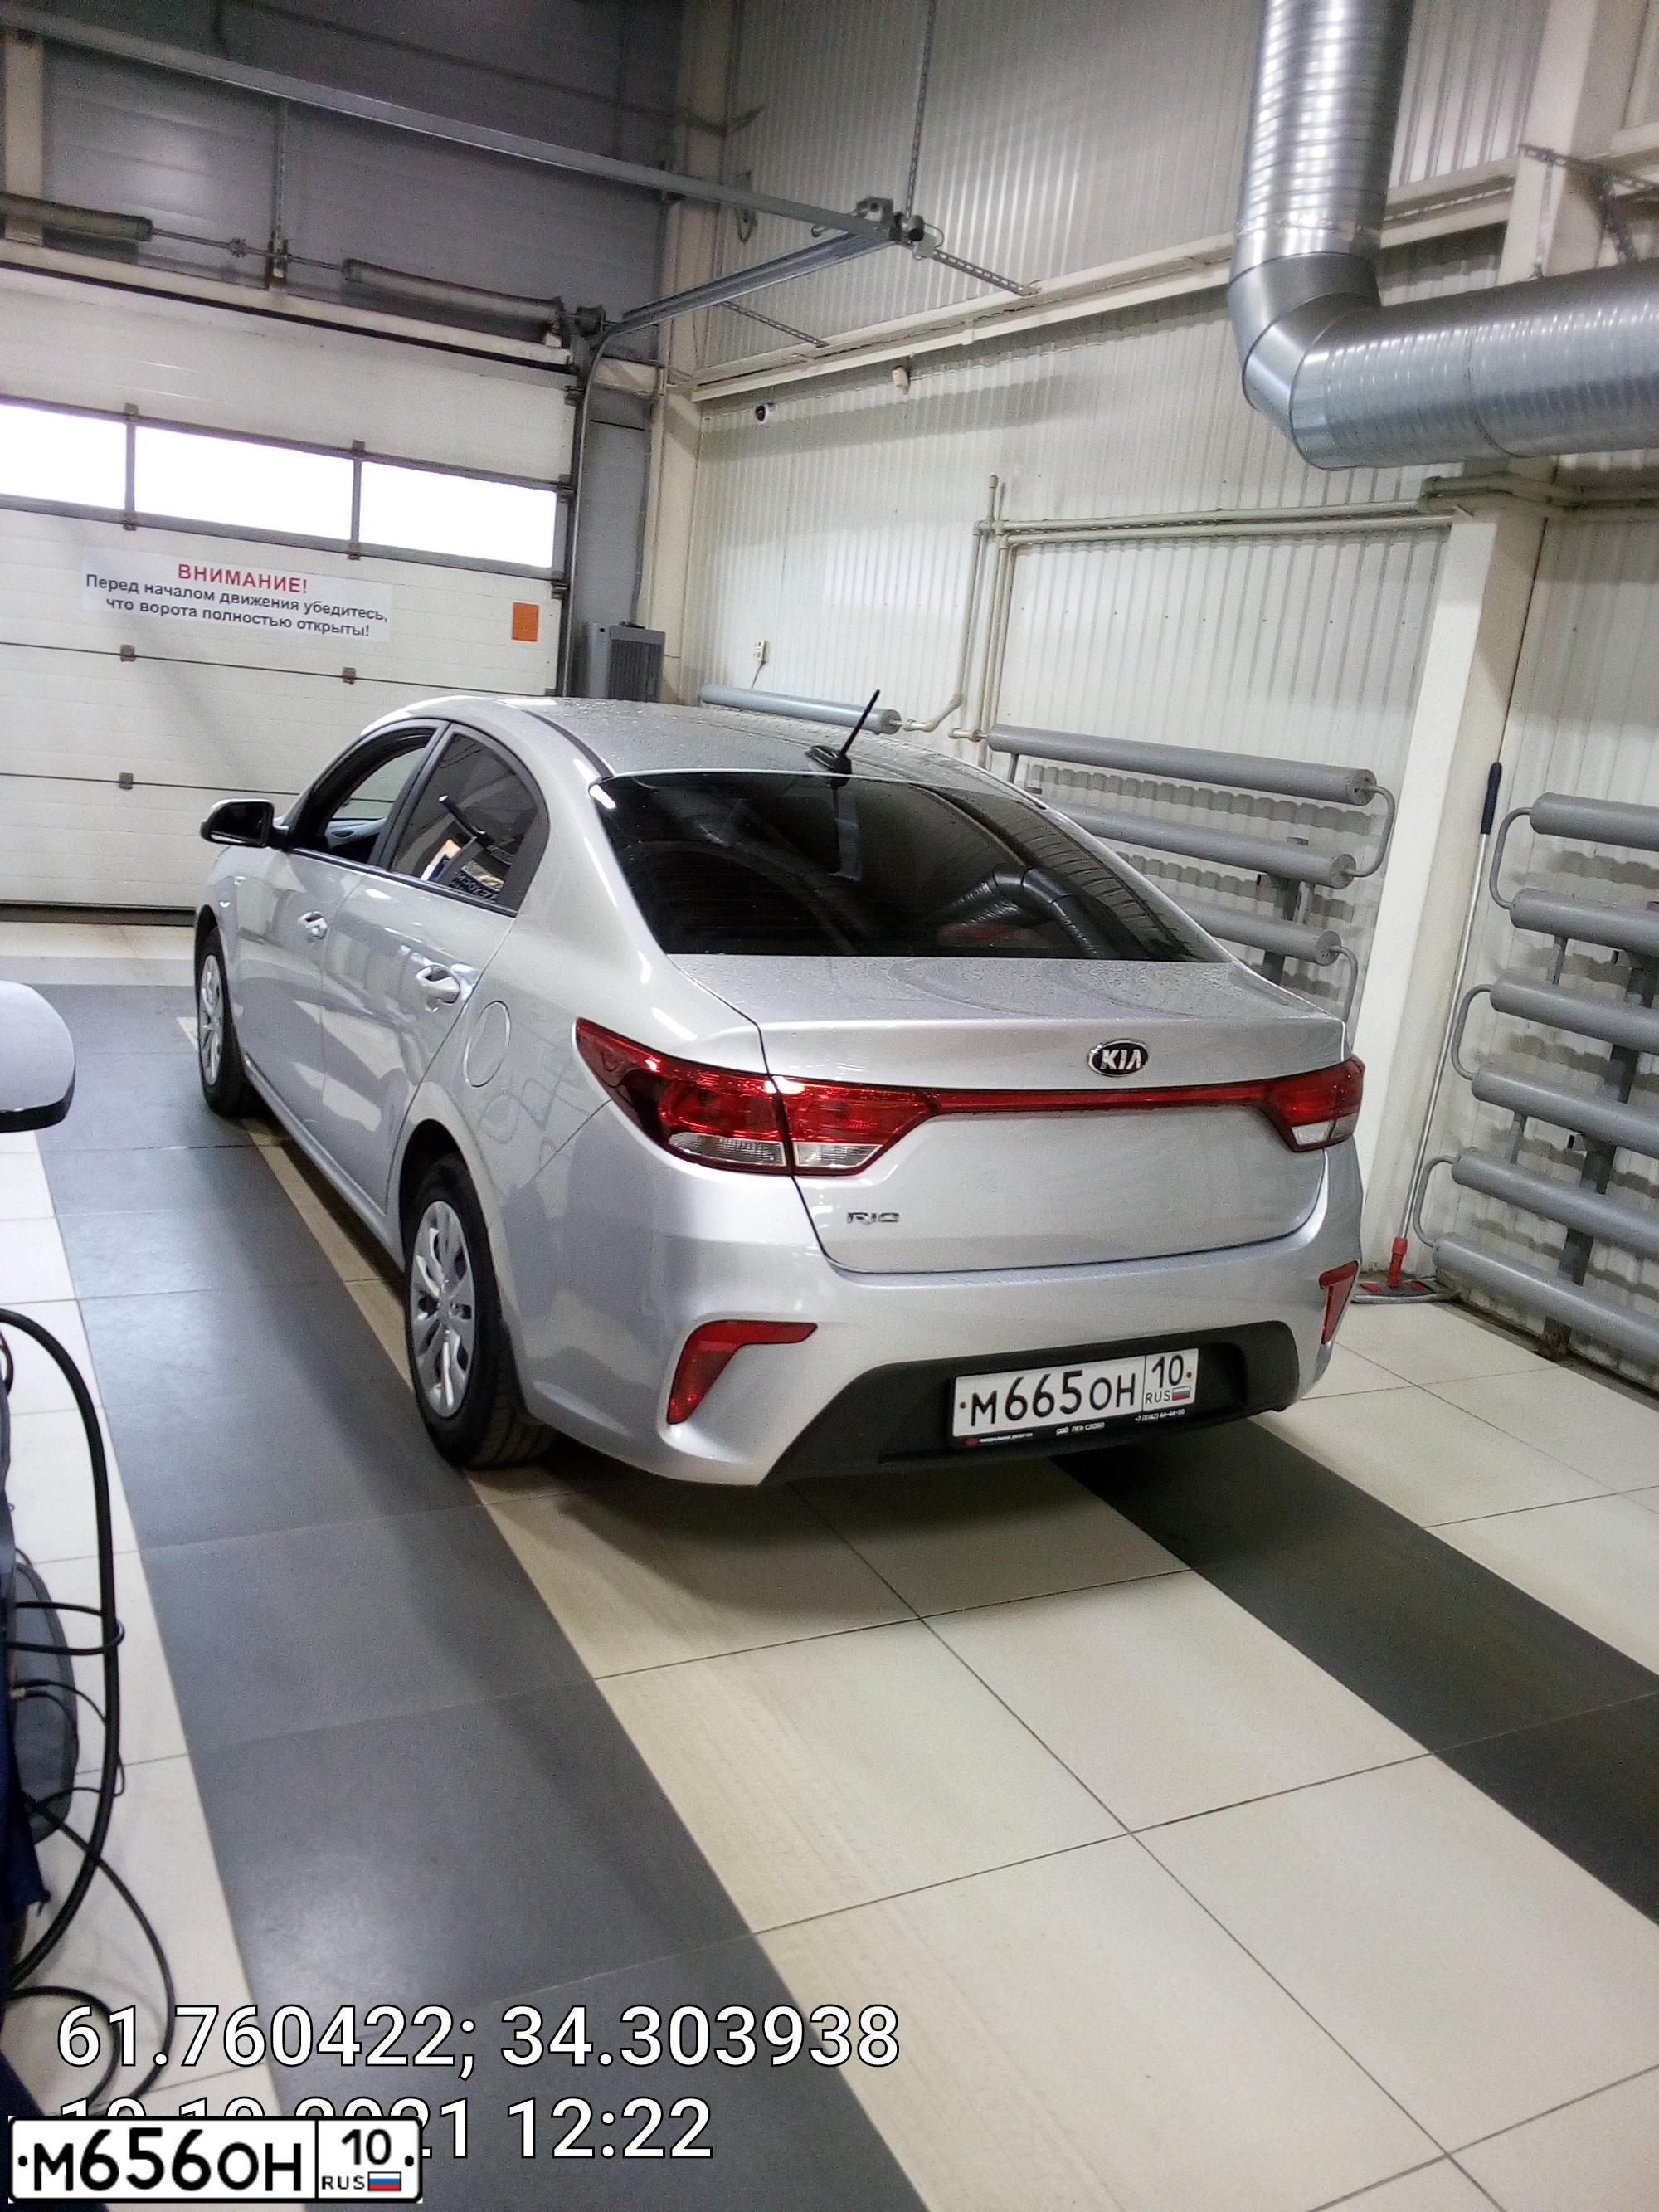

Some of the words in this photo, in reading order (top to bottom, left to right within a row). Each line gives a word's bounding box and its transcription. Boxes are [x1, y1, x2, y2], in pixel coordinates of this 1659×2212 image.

[178, 564, 307, 593] ВНИМАНИЕ!
[86, 574, 139, 594] Перед
[144, 583, 215, 601] началом
[219, 592, 299, 611] движения
[304, 601, 388, 622] убедитесь,
[106, 598, 134, 611] что
[139, 602, 197, 616] ворота
[202, 608, 292, 628] полностью
[297, 620, 369, 636] открыты!
[1101, 1049, 1141, 1070] KIA
[847, 1211, 900, 1225] RIO
[1151, 1354, 1184, 1388] 10
[1145, 1390, 1171, 1405] RUS
